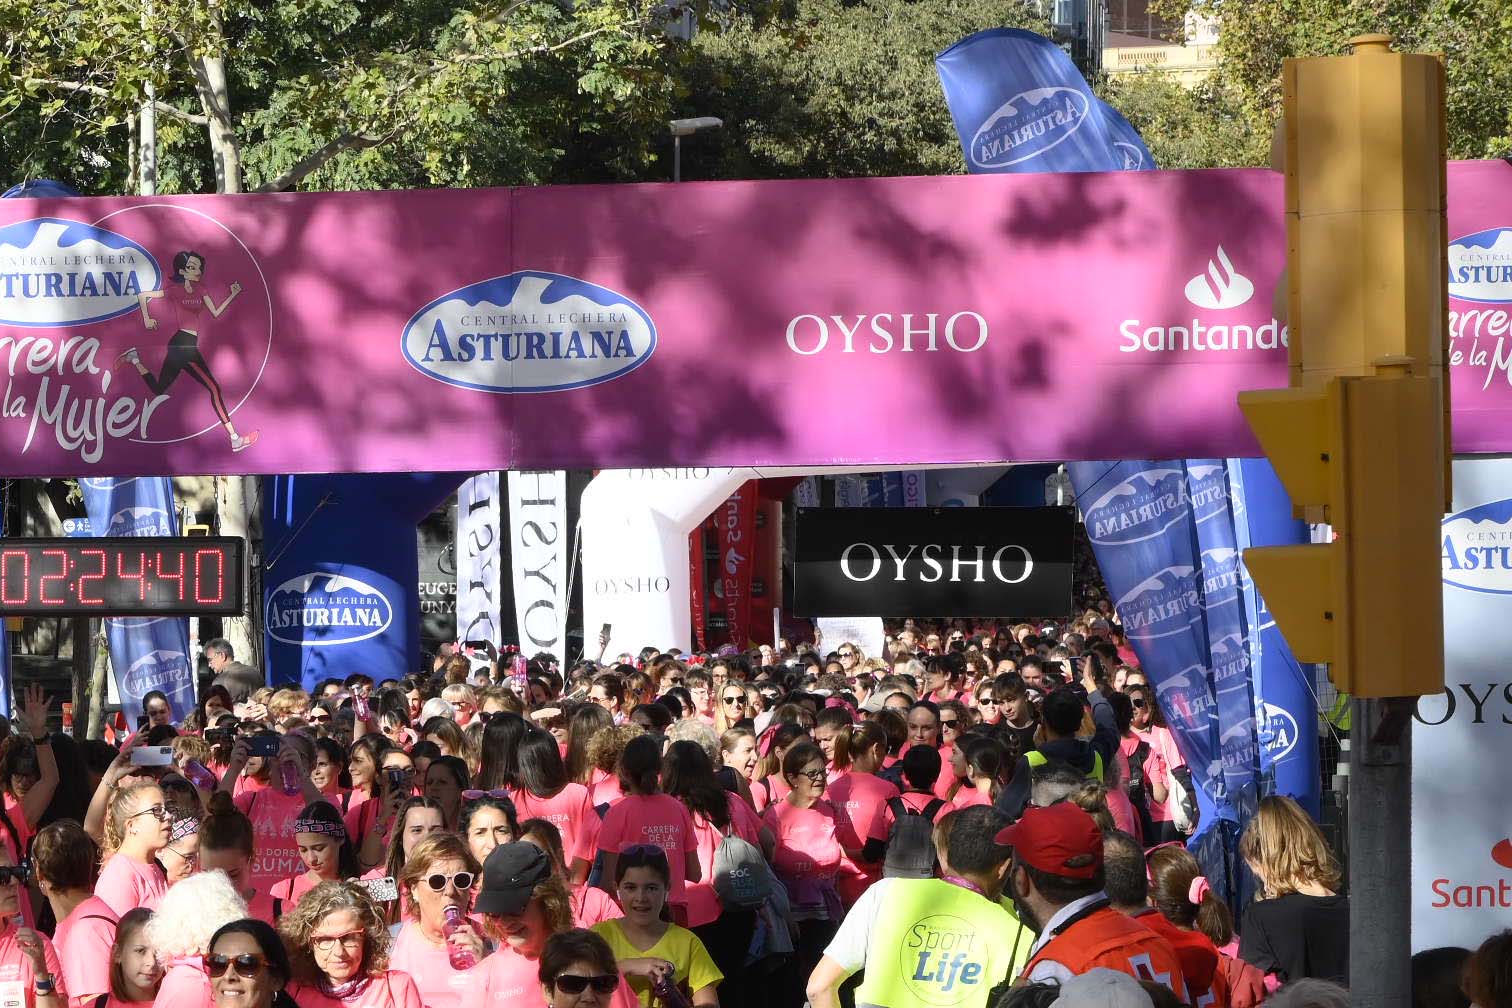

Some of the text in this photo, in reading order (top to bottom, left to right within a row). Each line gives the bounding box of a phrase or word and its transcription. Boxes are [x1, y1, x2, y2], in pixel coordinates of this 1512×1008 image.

[63, 254, 137, 266] LECHERA
[460, 311, 628, 327] CENTRAL LECHERA
[786, 310, 989, 355] OYSHO
[421, 318, 637, 363] ASTURIANA
[2, 377, 27, 418] la
[21, 370, 171, 464] Mujer
[1, 549, 223, 604] 02:24:40
[840, 542, 1034, 585] OYSHO
[270, 601, 383, 628] ASTURIANA
[329, 596, 378, 605] LECHERA
[641, 824, 681, 835] CARRERA
[908, 924, 977, 953] Sport
[912, 951, 982, 992] Life
